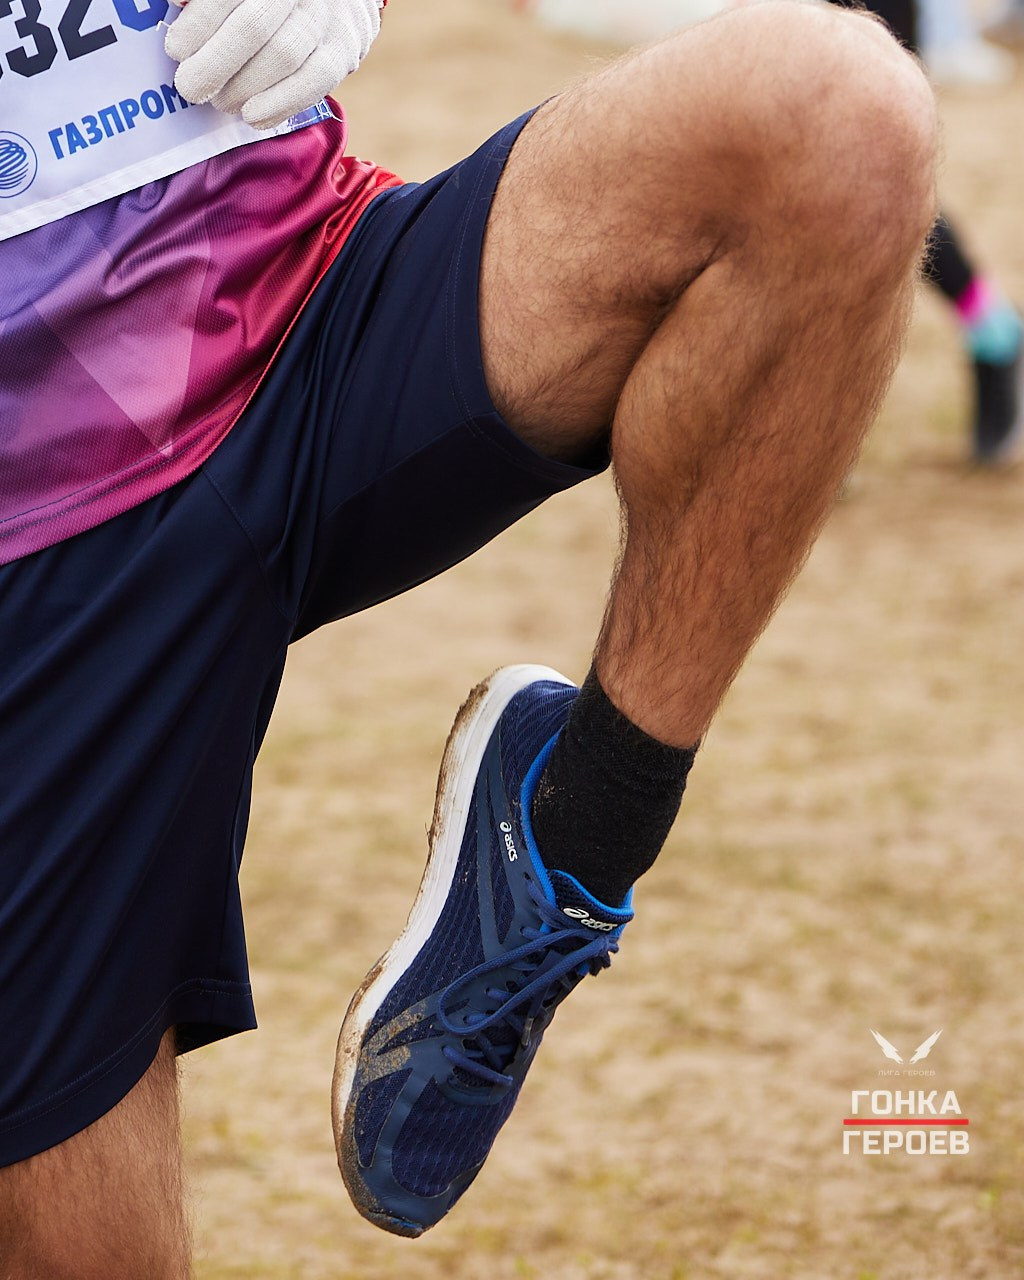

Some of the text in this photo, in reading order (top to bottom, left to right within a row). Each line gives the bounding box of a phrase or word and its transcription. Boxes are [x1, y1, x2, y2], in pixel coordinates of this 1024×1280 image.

[47, 80, 194, 161] ГАЗПРОМ
[504, 833, 518, 862] asics
[580, 917, 619, 932] asics
